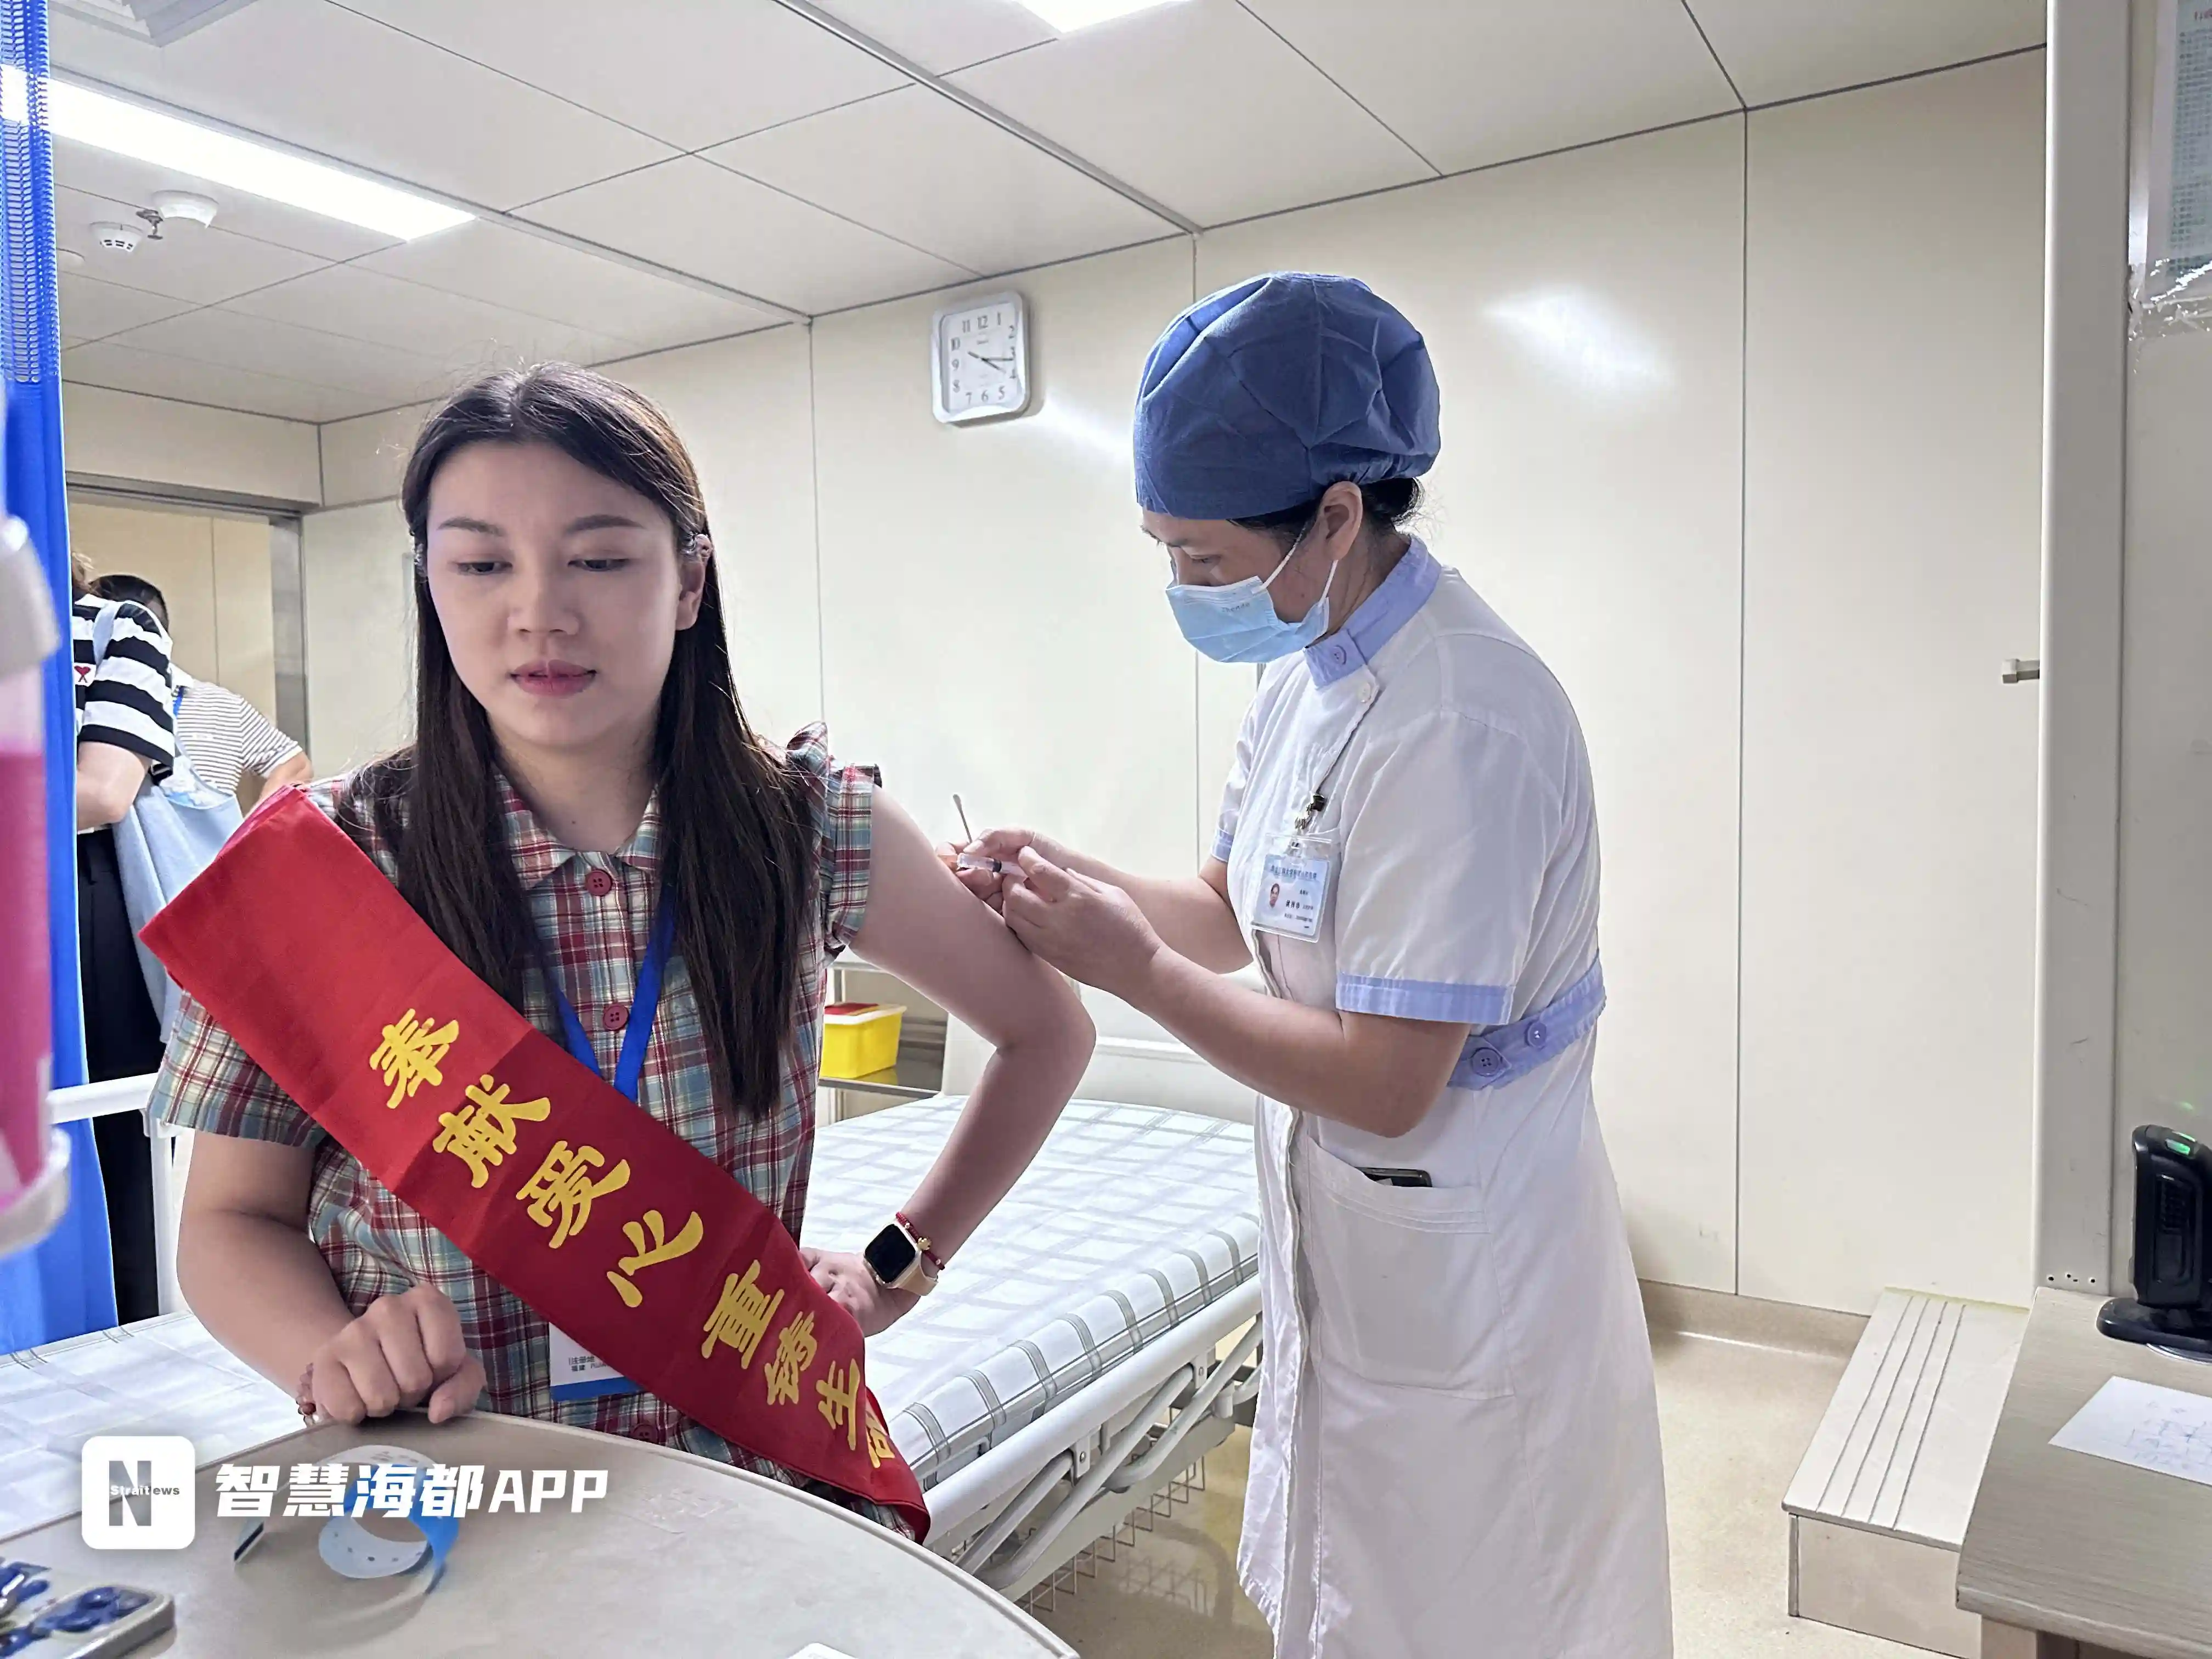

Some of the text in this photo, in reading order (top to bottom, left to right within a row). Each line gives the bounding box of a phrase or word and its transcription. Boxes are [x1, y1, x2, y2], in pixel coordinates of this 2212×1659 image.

[977, 314, 988, 329] 12
[997, 312, 1002, 325] 1
[962, 319, 971, 334] 11
[951, 358, 960, 371] 9
[952, 379, 961, 393] 8
[998, 385, 1006, 400] 5
[966, 392, 973, 404] 7
[980, 390, 989, 403] 6
[370, 1008, 704, 1307] 奉献爱心
